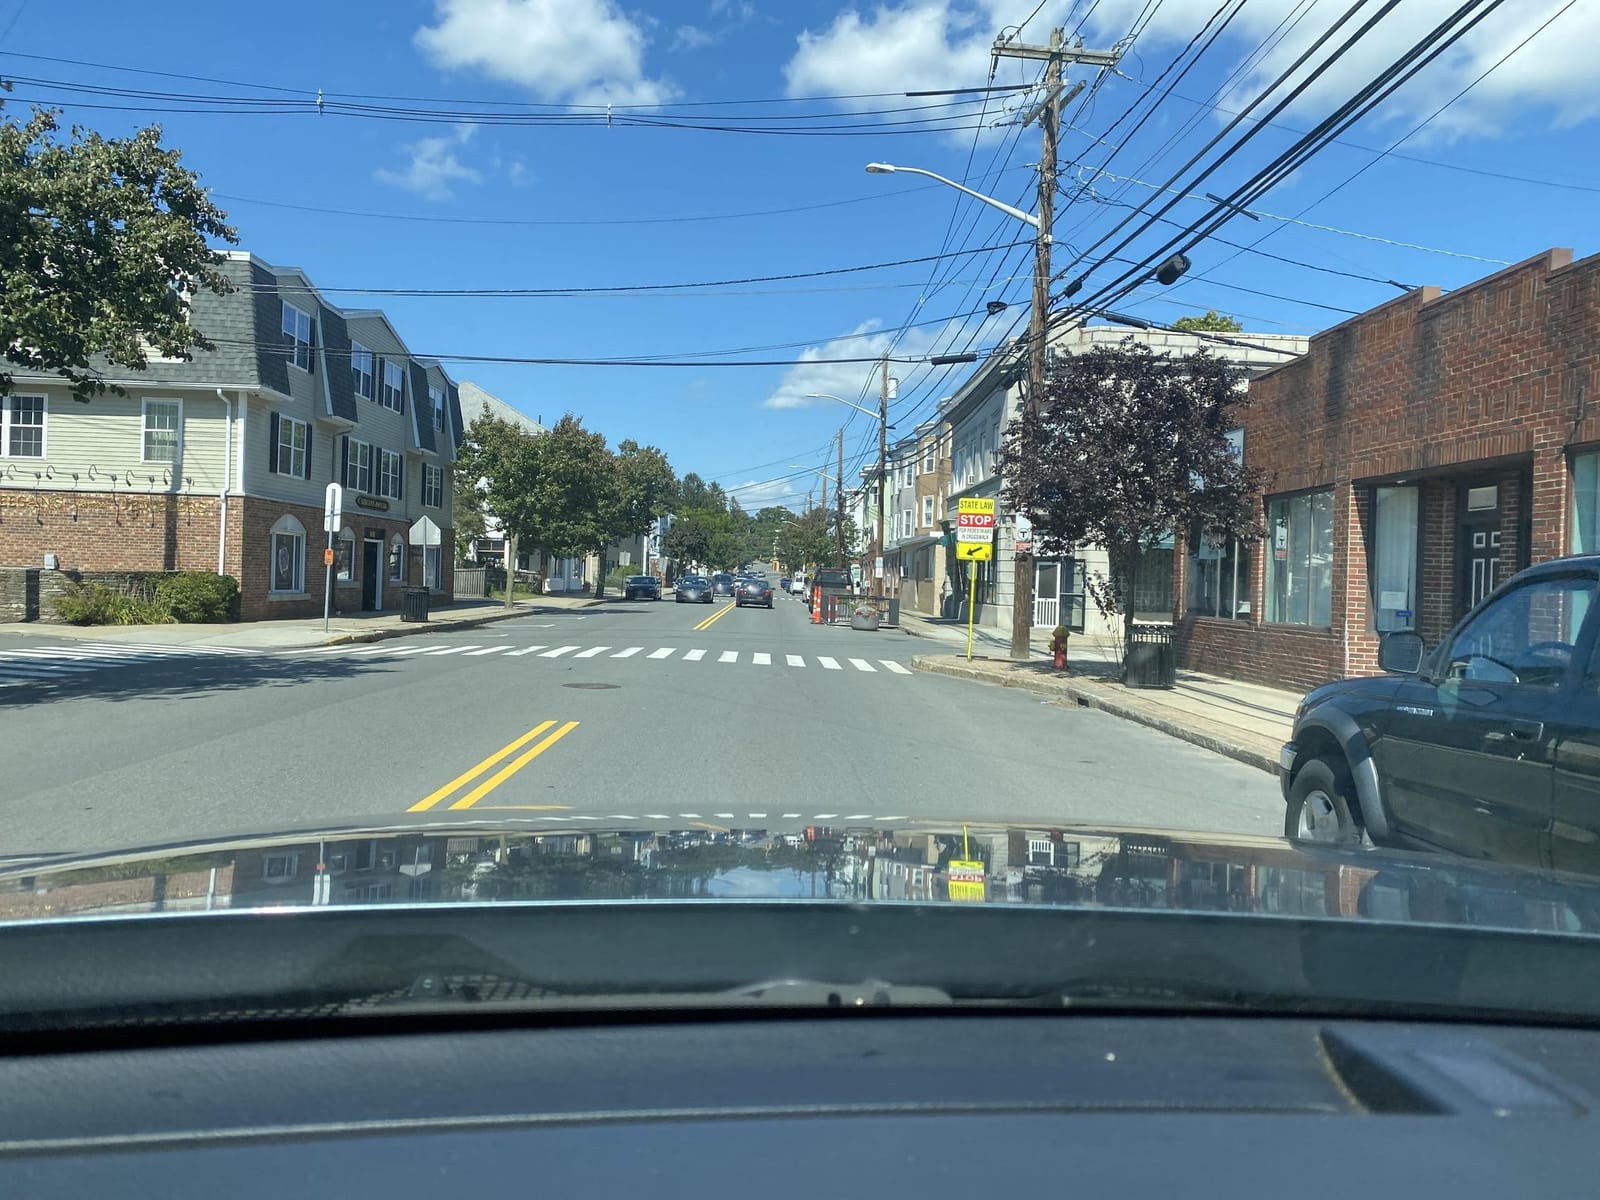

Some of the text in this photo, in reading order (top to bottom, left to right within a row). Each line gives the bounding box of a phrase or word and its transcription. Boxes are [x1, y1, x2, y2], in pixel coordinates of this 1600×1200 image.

[960, 501, 993, 509] STATE LAW
[961, 515, 991, 525] STOP
